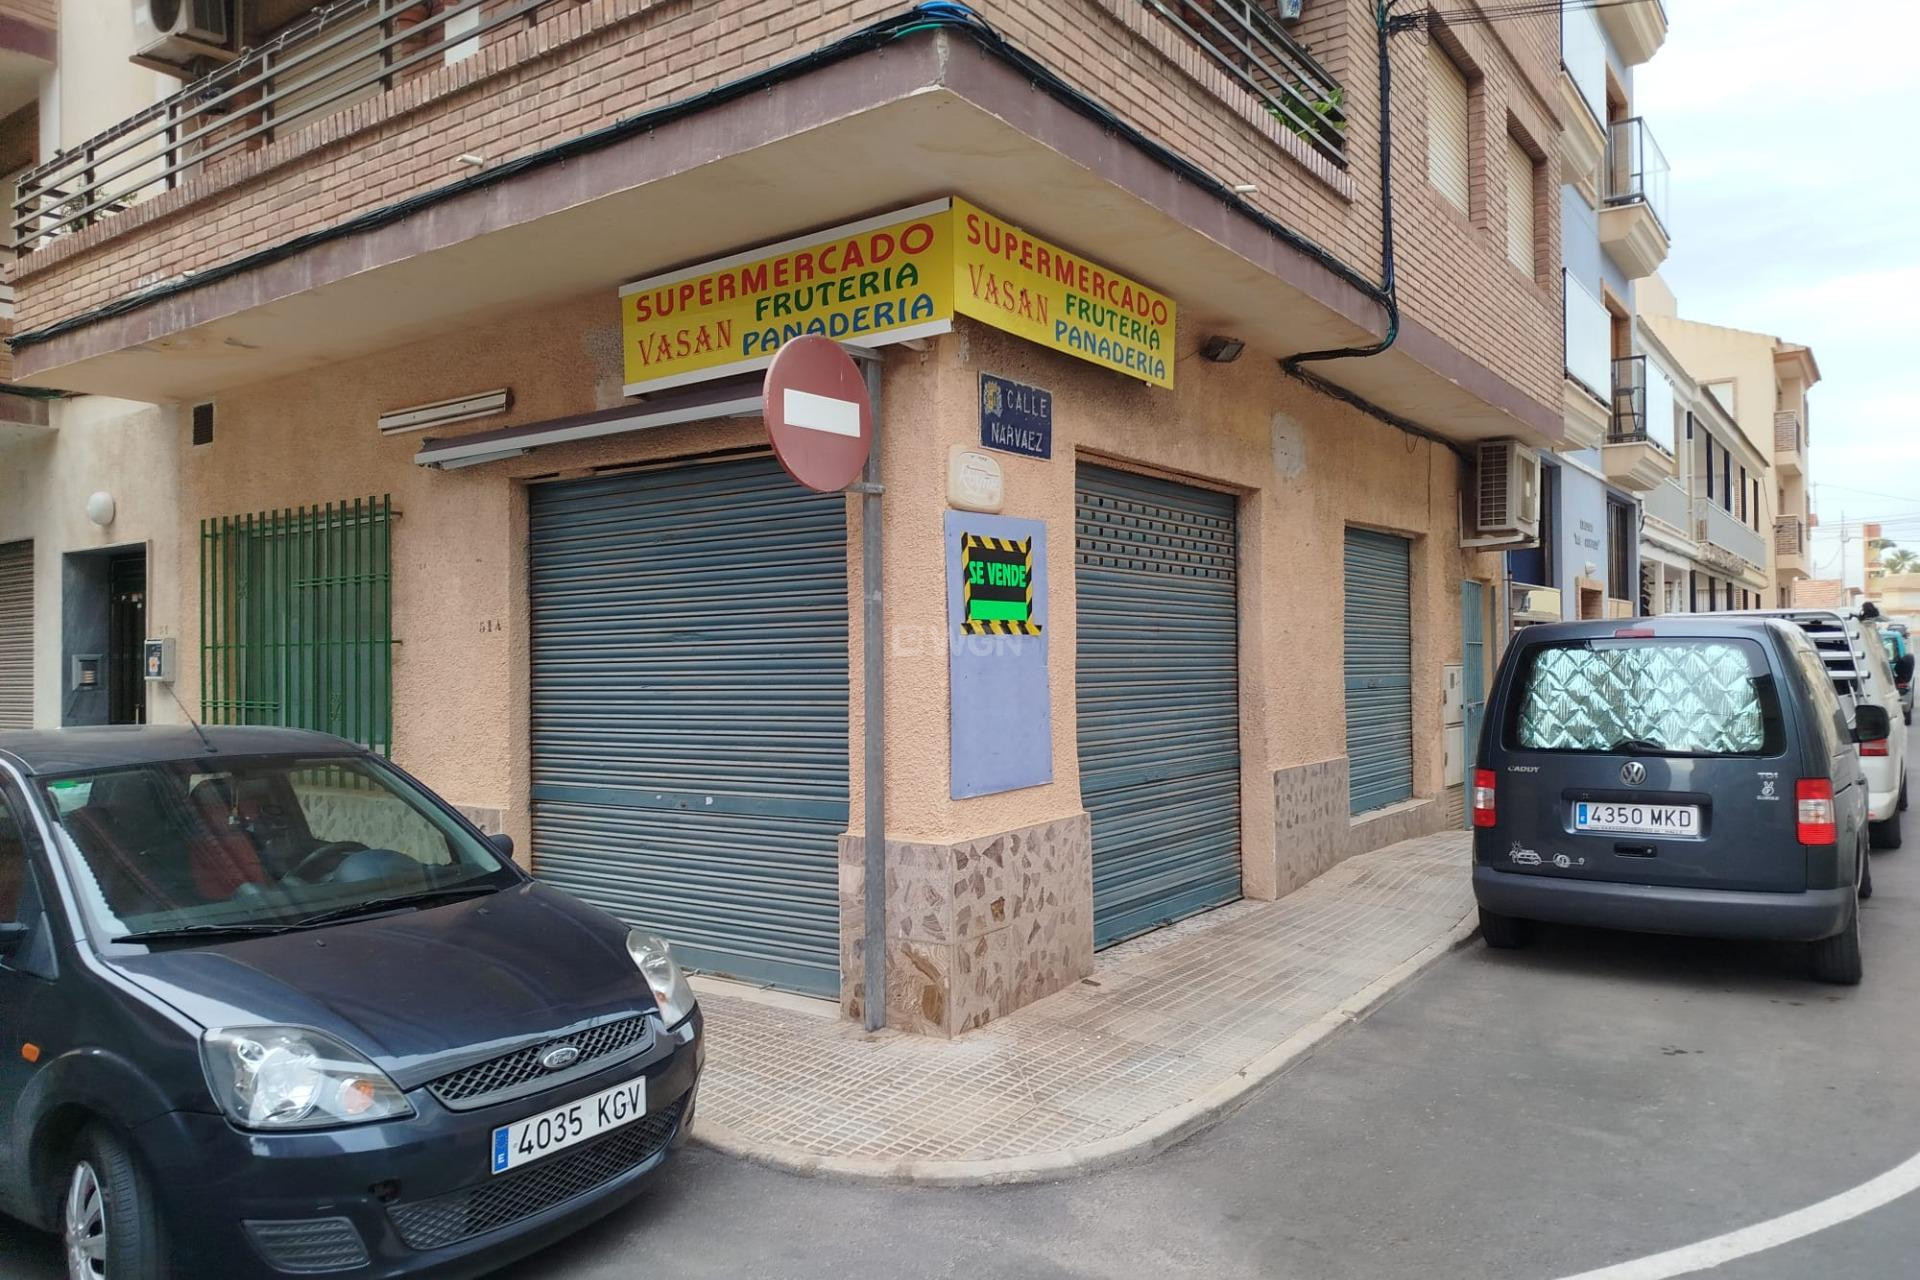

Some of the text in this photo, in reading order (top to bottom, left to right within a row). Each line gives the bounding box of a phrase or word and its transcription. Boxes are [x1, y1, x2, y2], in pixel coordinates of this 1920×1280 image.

[636, 223, 934, 322] SUPERMERCADO
[756, 262, 919, 321] FRUTERIA
[967, 214, 1168, 326] SUPERMERCADO
[968, 263, 1049, 326] VASAN
[638, 319, 733, 366] VASAN
[742, 293, 934, 356] PANADERIA
[1055, 319, 1165, 380] PANADERIA
[1065, 293, 1160, 350] FRUTERIA
[1007, 389, 1047, 418] CALLE
[991, 422, 1043, 452] NARVAEZ
[969, 560, 1027, 587] SE VENDE
[1507, 765, 1540, 773] CADDY
[1591, 806, 1643, 825] 4350
[1650, 808, 1691, 828] MKD
[498, 1083, 640, 1164] E 4035 KGV
